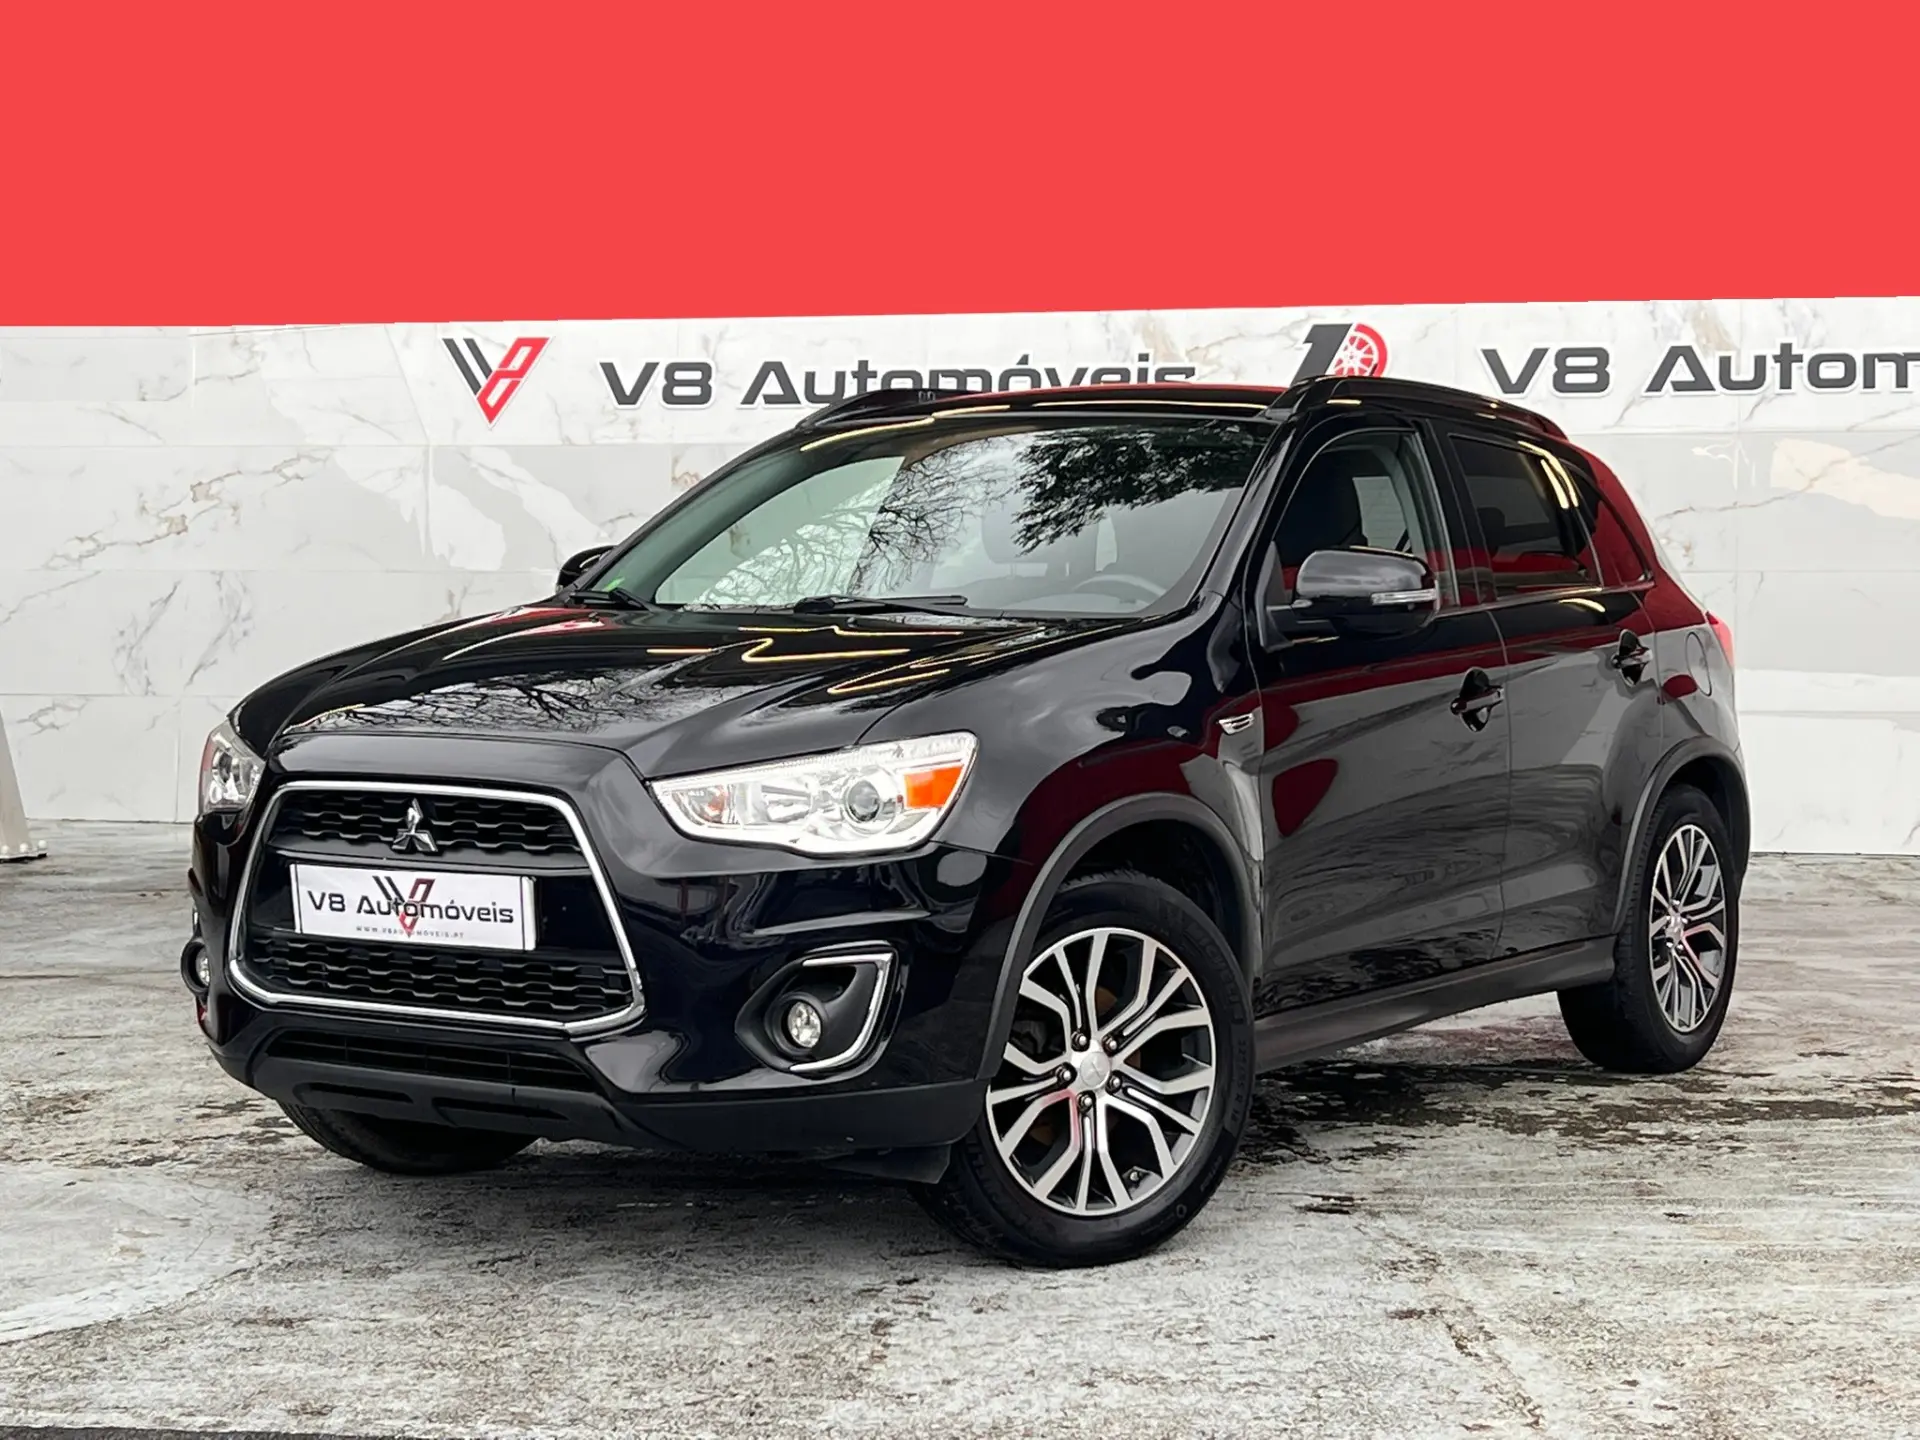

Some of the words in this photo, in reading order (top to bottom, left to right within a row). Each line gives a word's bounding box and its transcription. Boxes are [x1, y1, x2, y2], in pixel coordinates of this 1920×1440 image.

[600, 361, 712, 405] V8
[1482, 347, 1609, 394] V8
[308, 890, 346, 912] V8
[356, 896, 514, 923] Automóveis
